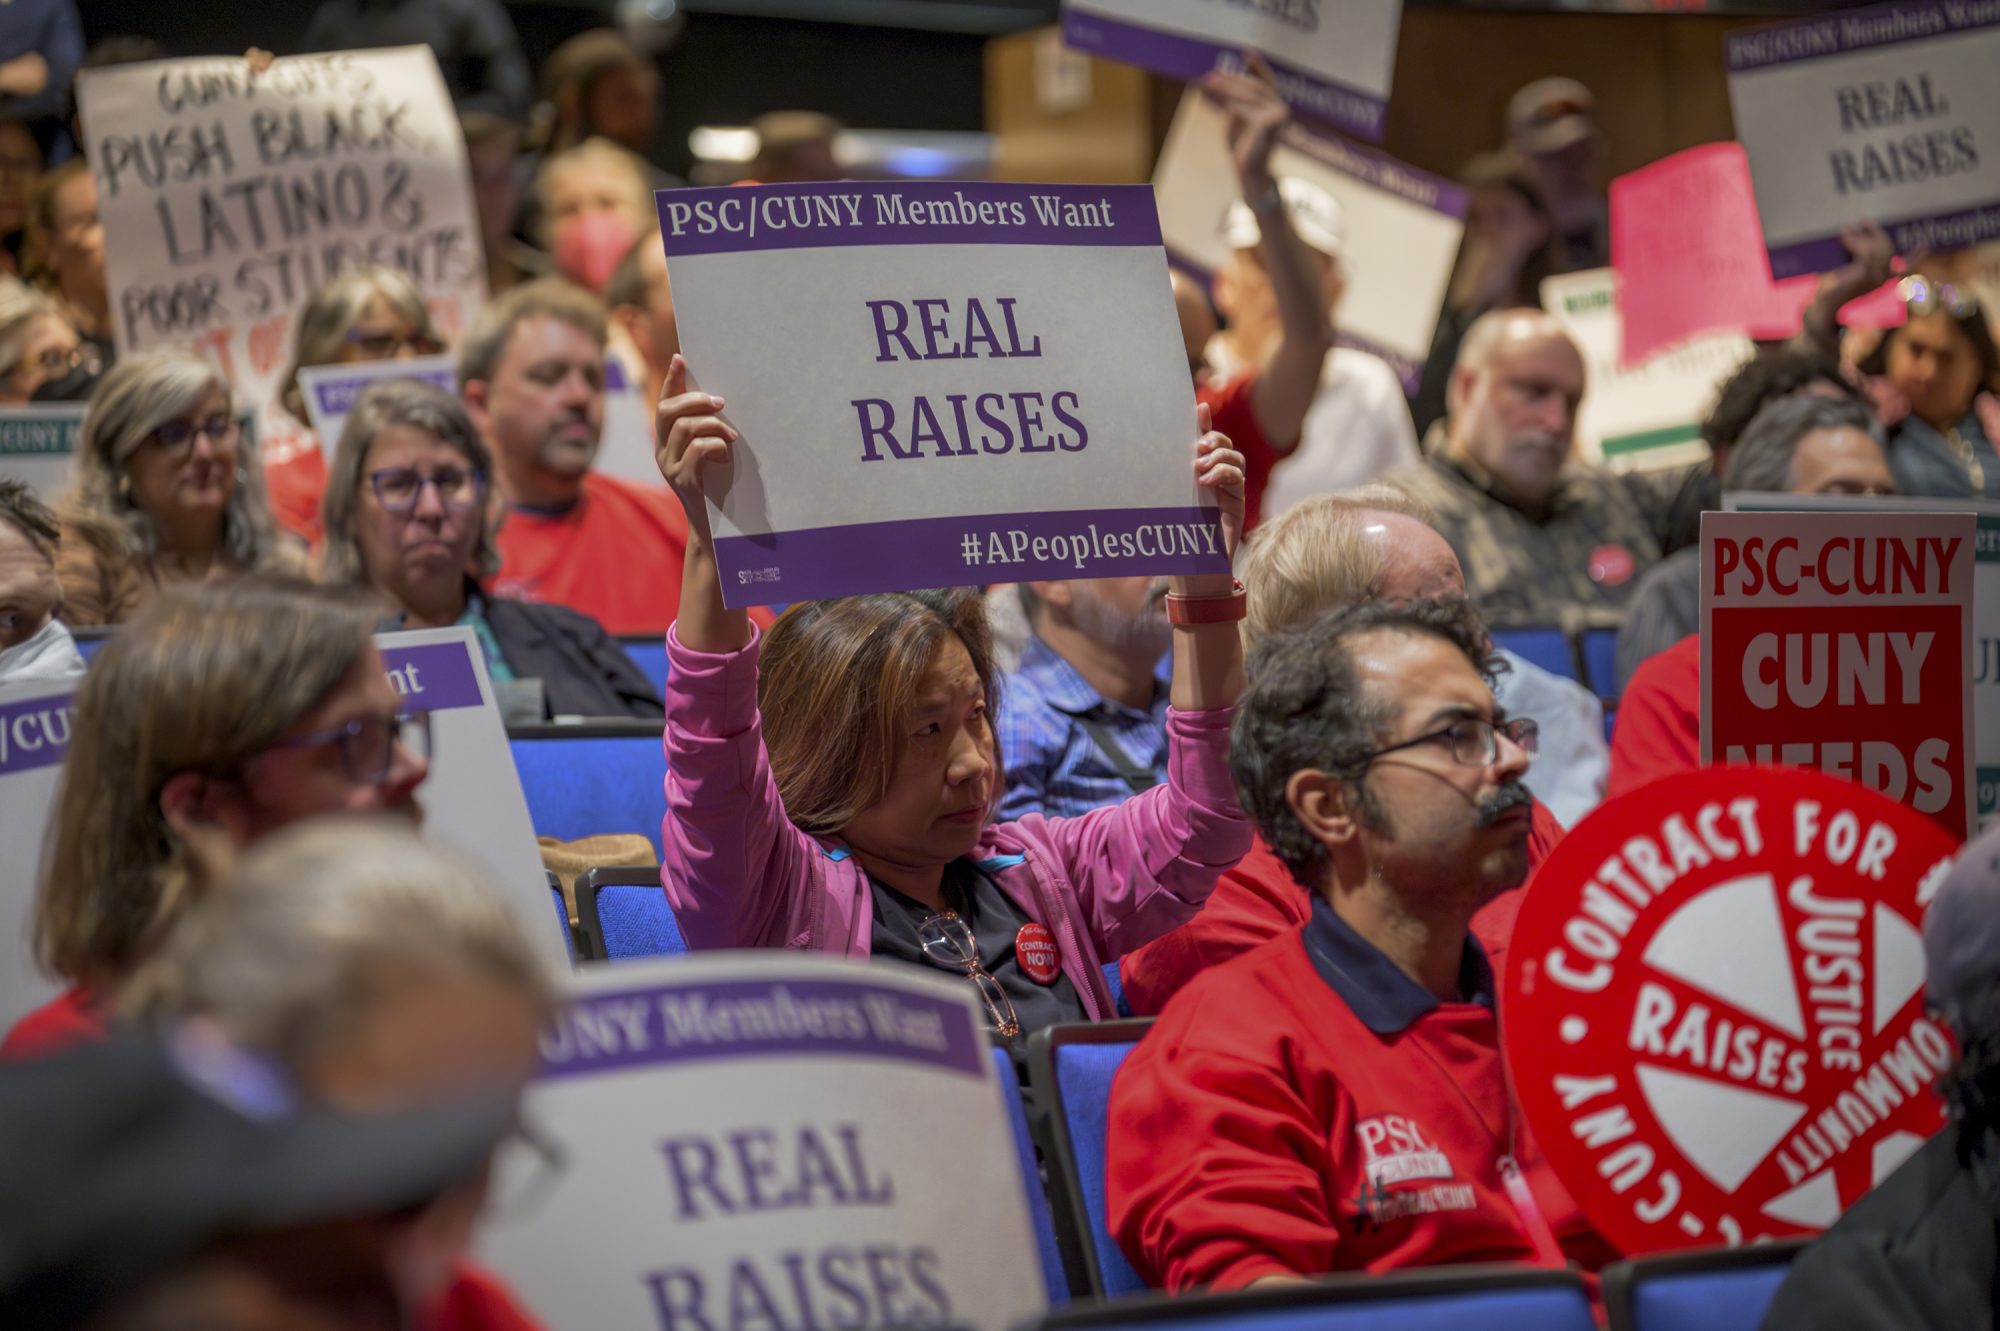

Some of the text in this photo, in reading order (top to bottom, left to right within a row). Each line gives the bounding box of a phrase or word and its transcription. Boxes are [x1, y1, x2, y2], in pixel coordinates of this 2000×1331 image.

[1835, 74, 1948, 132] REAL
[102, 124, 234, 197] PUSH
[1829, 127, 1979, 194] RAISES
[155, 162, 371, 265] LATINO
[667, 192, 1115, 238] PSC/CUNY Members Want
[122, 272, 230, 348] POOR
[865, 297, 1043, 363] REAL
[851, 391, 1089, 463] RAISES
[960, 524, 1218, 569] #APeoplesCUNY
[1713, 536, 1964, 597] PSC-CUNY
[386, 662, 424, 695] nt
[1741, 631, 1936, 709] CUNY
[0, 706, 74, 762] /CU
[1544, 797, 1898, 993] CONTRACT FOR
[1019, 941, 1057, 952] CONTRACT
[1026, 952, 1055, 966] NOW
[1787, 874, 1867, 1072] JUSTICE
[660, 985, 866, 1047] Members
[1626, 982, 1809, 1094] RAISES
[1775, 1018, 1952, 1184] OMMUNITY
[659, 1120, 897, 1222] REAL
[640, 1242, 956, 1331] RAISES
